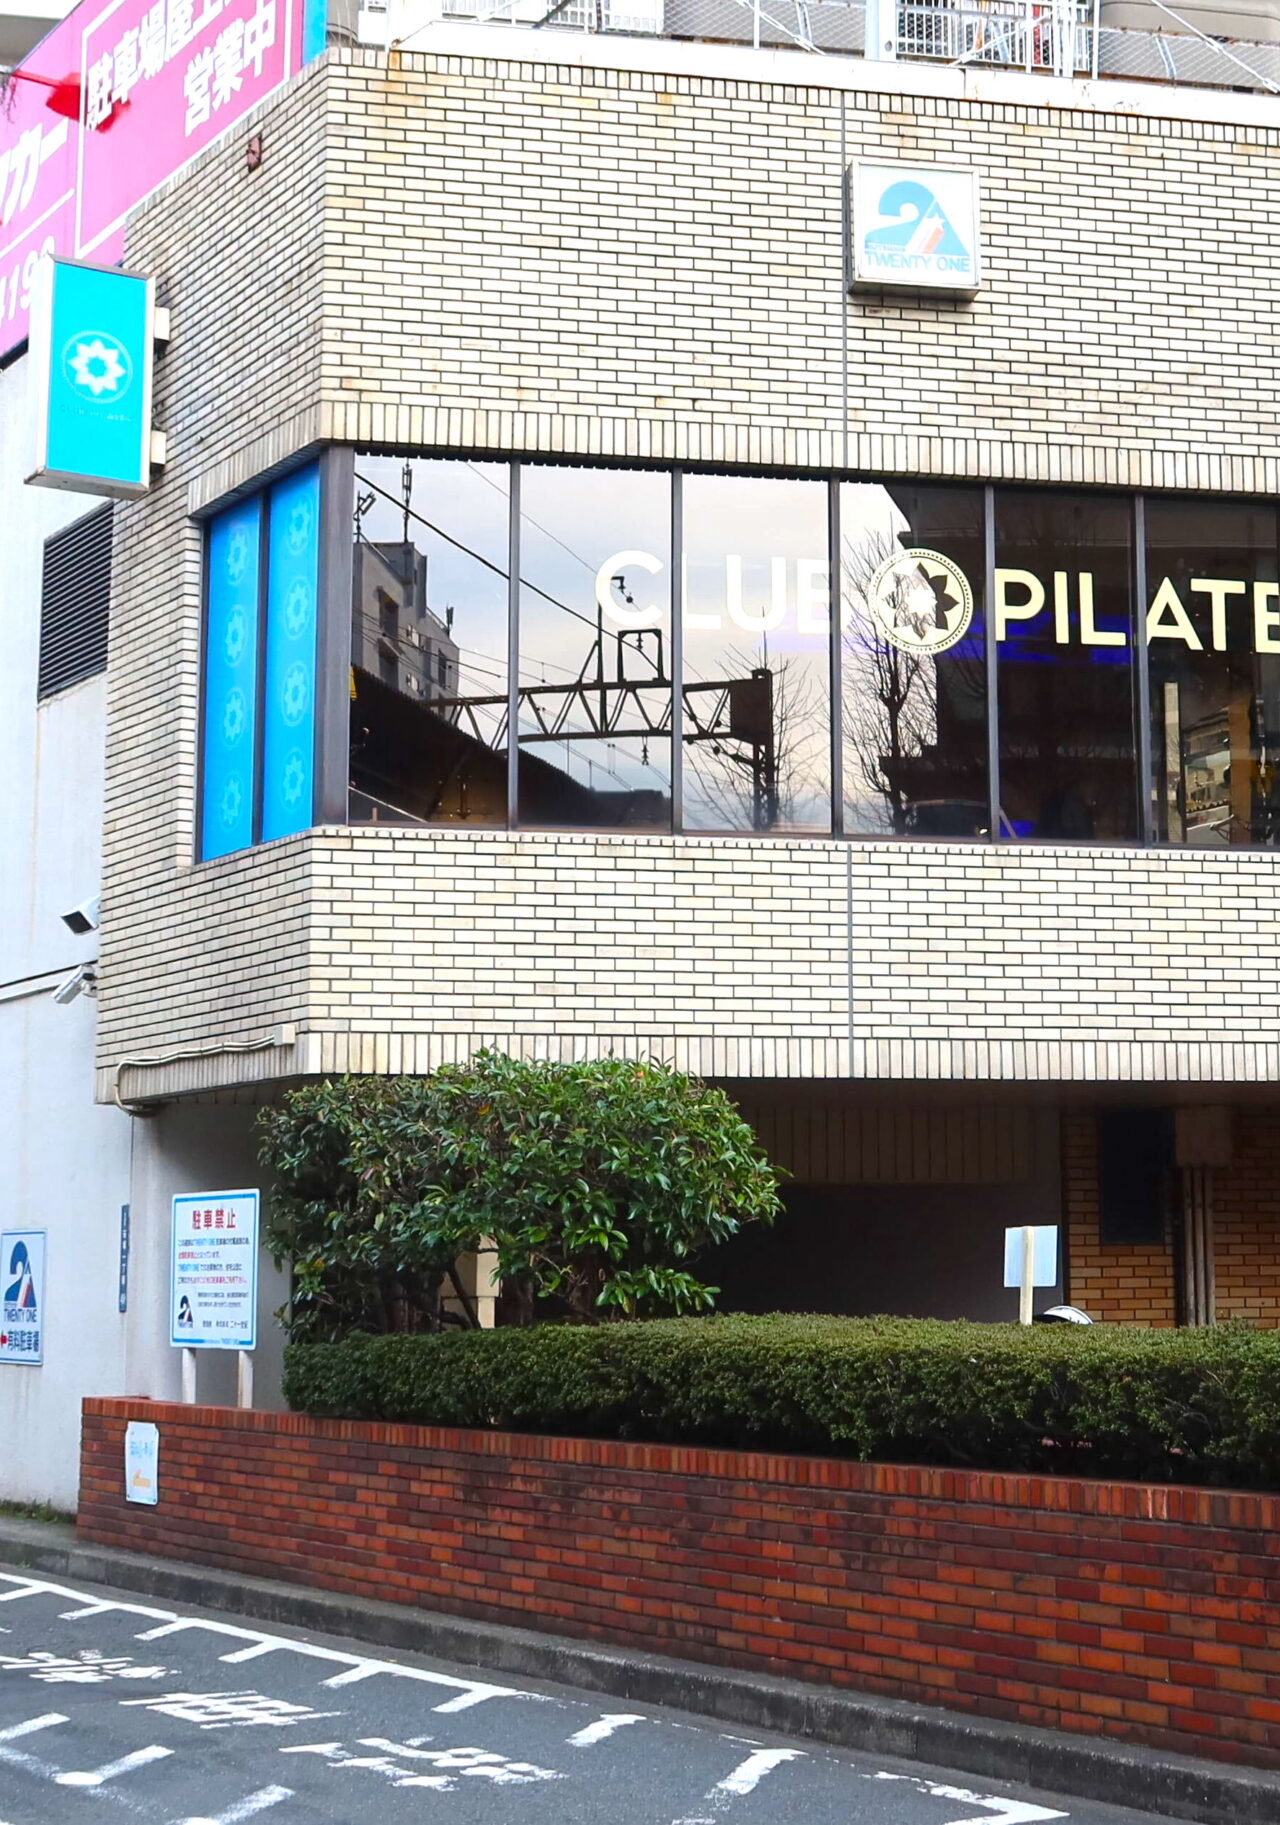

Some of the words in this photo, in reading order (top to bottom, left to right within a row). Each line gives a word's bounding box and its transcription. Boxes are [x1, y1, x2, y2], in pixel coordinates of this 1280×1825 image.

[86, 0, 233, 131] 駐車場屋上
[184, 0, 276, 137] 営業中
[0, 117, 69, 226] カー
[865, 251, 932, 270] TWENTY
[936, 256, 971, 272] ONE
[595, 550, 852, 634] CLUB
[192, 1208, 237, 1230] 駐車禁止
[4, 1309, 24, 1322] TWENTY
[26, 1310, 37, 1322] ONE
